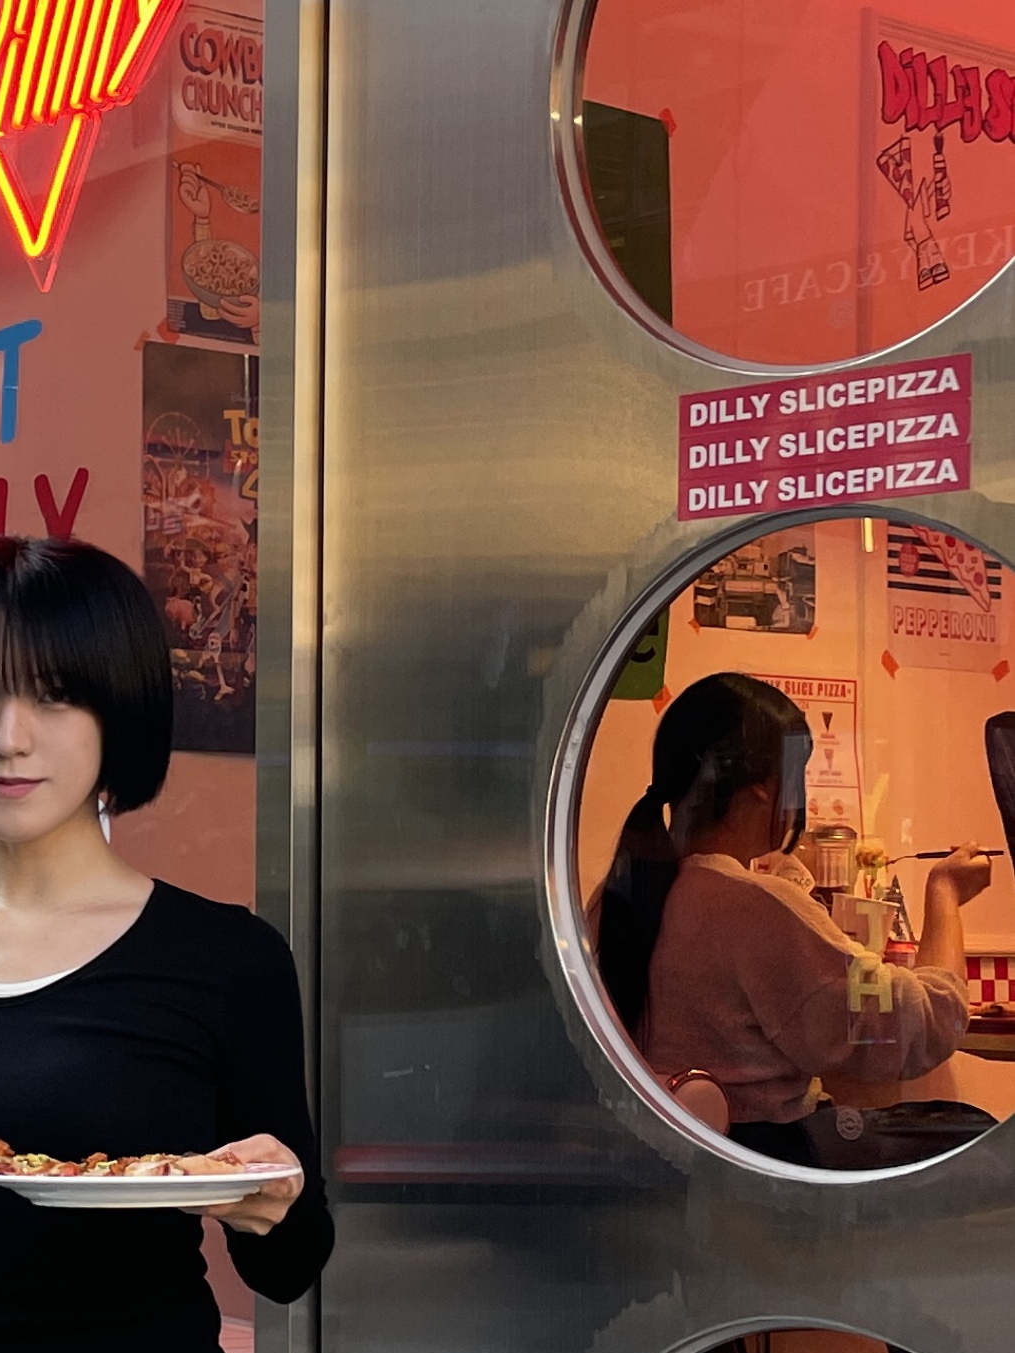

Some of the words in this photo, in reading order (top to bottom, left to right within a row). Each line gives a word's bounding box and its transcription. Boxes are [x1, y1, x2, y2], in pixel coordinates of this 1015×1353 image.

[180, 22, 264, 86] COWB
[182, 75, 263, 124] CRUNCH
[690, 393, 771, 427] DILLY
[779, 367, 960, 415] SLICEPIZZA
[689, 436, 770, 469] DILLY
[778, 412, 959, 459] SLICEPIZZA
[688, 480, 768, 511] DILLY
[777, 458, 958, 501] SLICEPIZZA
[893, 605, 995, 643] PEPPERONI
[785, 680, 813, 696] SLICE
[817, 683, 846, 698] PIZZA
